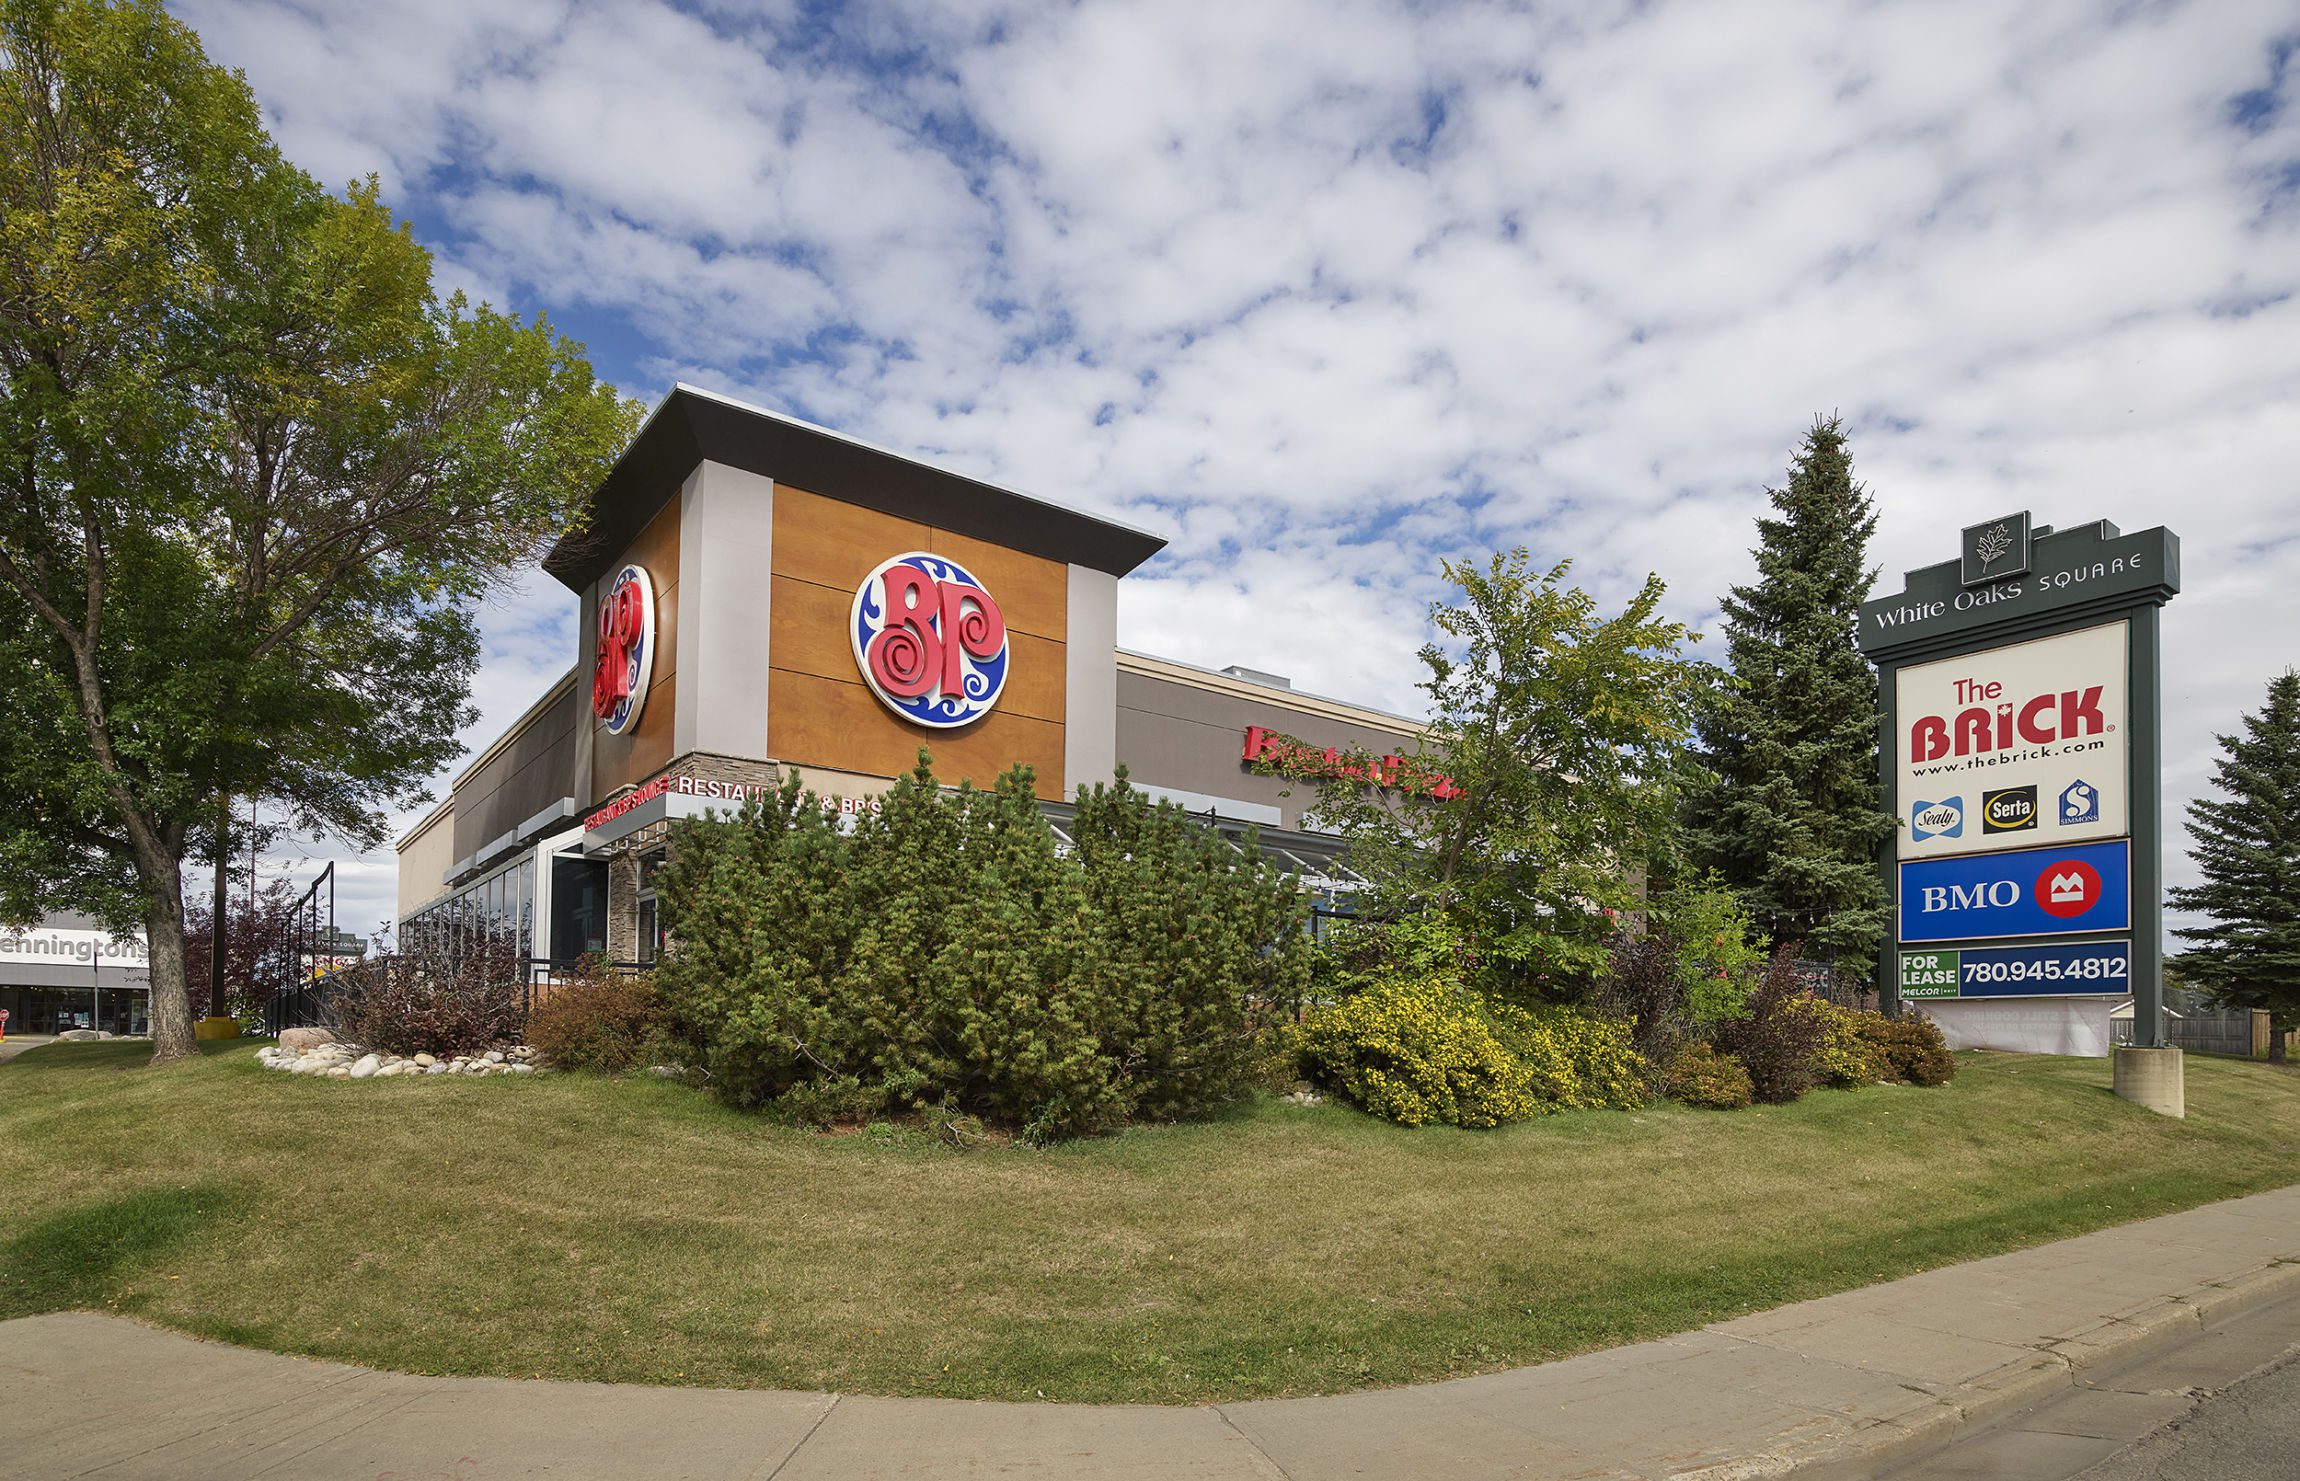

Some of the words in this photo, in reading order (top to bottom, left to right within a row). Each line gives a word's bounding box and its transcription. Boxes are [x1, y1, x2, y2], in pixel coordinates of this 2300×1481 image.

[1875, 602, 1946, 629] White
[1953, 582, 2022, 611] Oaks
[2039, 553, 2141, 592] SQUARE
[1953, 678, 2002, 705] The
[1912, 740, 2105, 776] www.thebrick.com
[820, 795, 836, 811] &
[1993, 800, 2030, 818] Serta
[1918, 808, 1953, 827] Sealy
[2060, 814, 2098, 824] SIMMONS
[1921, 880, 2021, 913] BMO
[1902, 955, 1939, 970] FOR
[1963, 957, 2127, 983] 780.945.4812
[1902, 970, 1956, 985] LEASE
[1902, 988, 1940, 996] MELCOR
